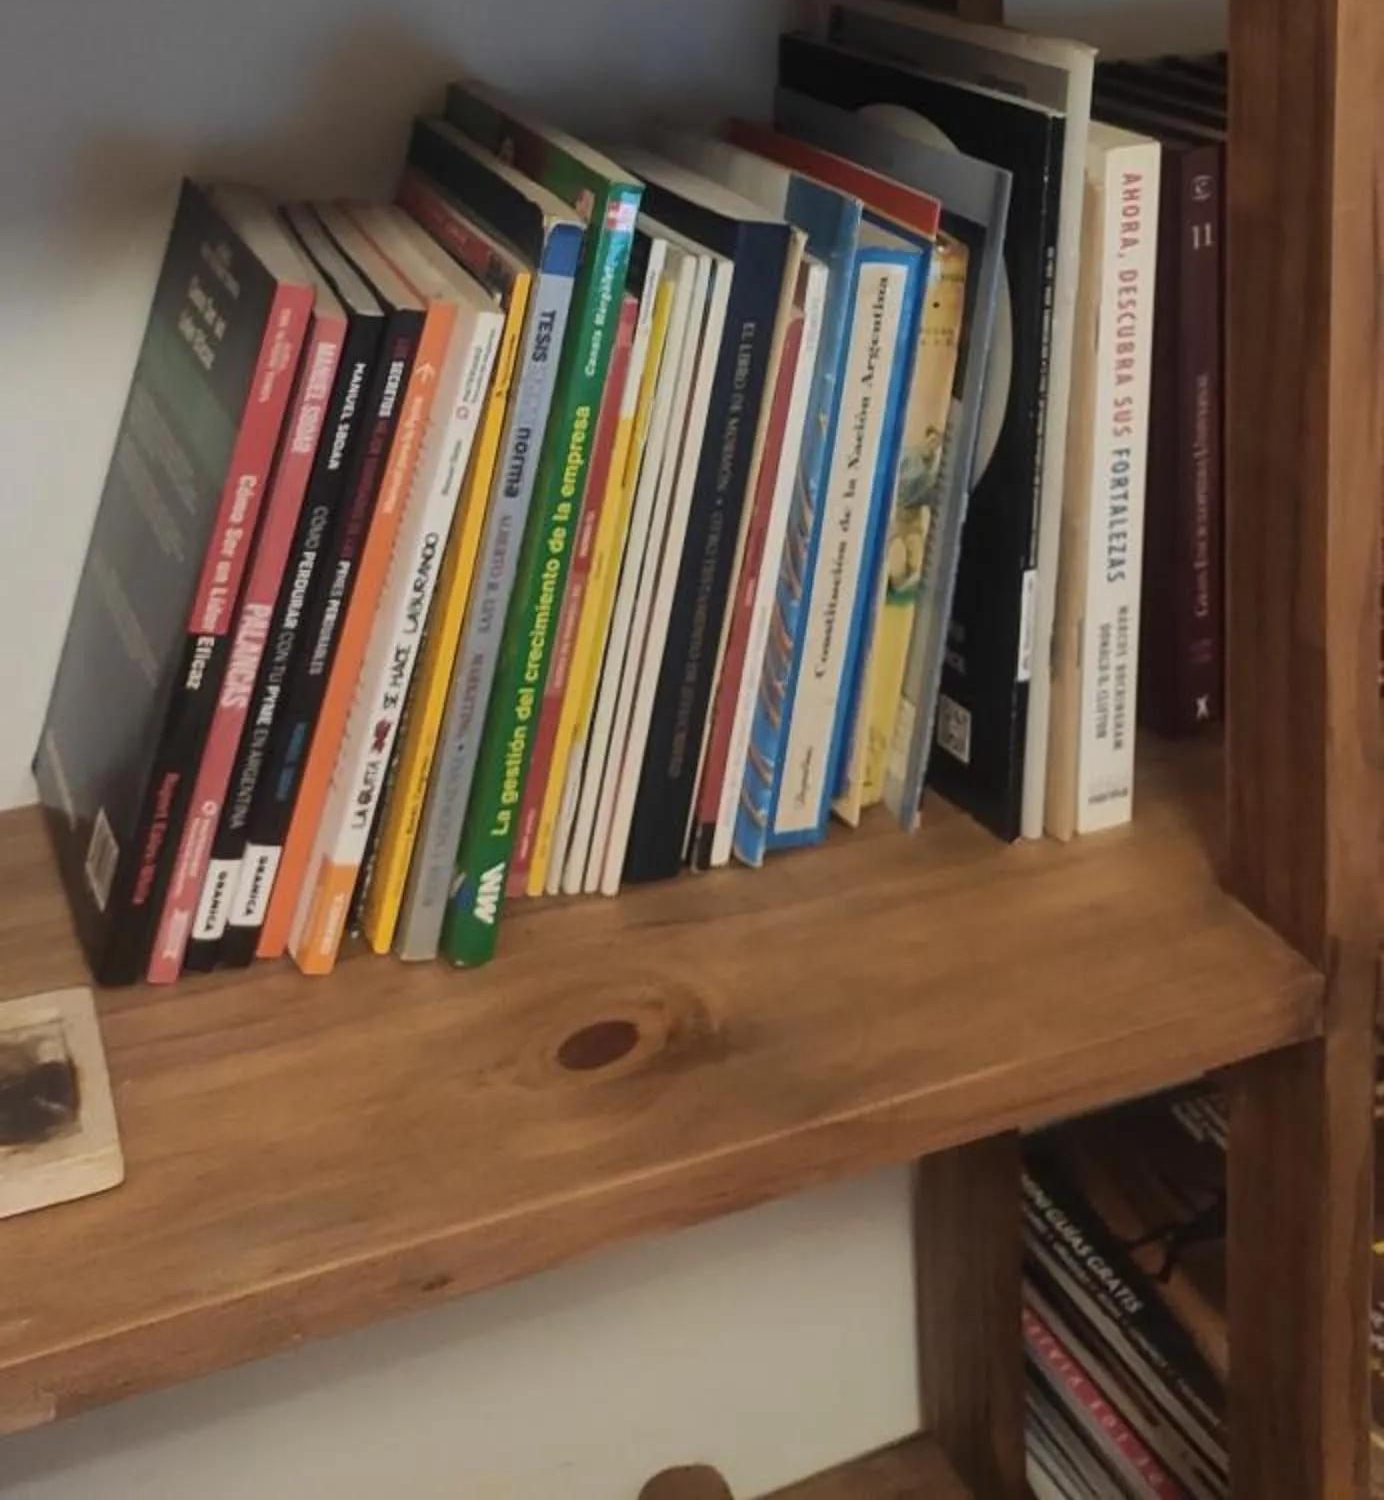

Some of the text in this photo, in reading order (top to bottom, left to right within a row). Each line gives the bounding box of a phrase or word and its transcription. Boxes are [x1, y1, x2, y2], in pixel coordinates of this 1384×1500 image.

[341, 362, 367, 422] MANUEL
[379, 361, 405, 418] SECRETOS
[504, 310, 556, 497] TESIS norma
[1107, 173, 1142, 583] AHORA, DESCUBRA SUS FORTALEZAS
[561, 406, 590, 497] empresa
[816, 276, 889, 678] Constitución de la Nación Argentina
[549, 527, 565, 553] de
[553, 501, 571, 522] la
[216, 562, 230, 582] un
[222, 527, 244, 557] Ser
[284, 552, 317, 629] PERDURAR
[407, 532, 439, 632] LABURANDO
[525, 559, 559, 681] crecimiento
[187, 636, 216, 690] Eficaz
[221, 604, 270, 709] PALANCAS
[387, 644, 412, 687] HACE
[258, 685, 282, 726] PYME
[384, 693, 399, 709] SE
[517, 686, 535, 720] del
[230, 747, 264, 829] ARGENTINA
[502, 725, 527, 805] gestión
[492, 811, 509, 835] La
[204, 871, 228, 932] GRANICA
[245, 855, 268, 916] GRANICA
[1087, 1256, 1144, 1313] GRATIS
